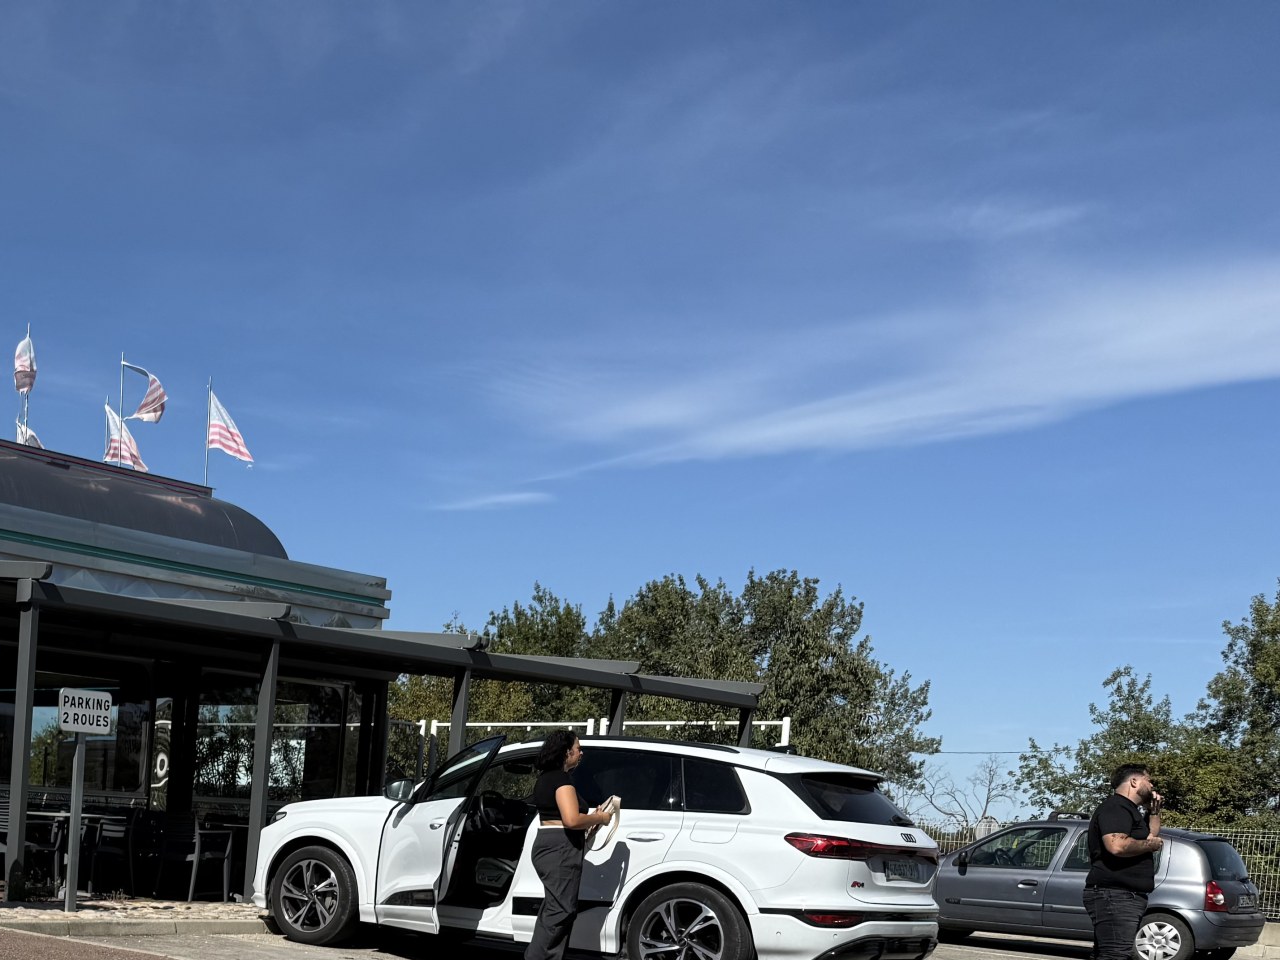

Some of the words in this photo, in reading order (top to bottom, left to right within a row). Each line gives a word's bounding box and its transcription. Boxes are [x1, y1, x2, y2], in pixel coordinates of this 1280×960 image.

[63, 695, 111, 712] PARKING
[62, 711, 69, 724] 2
[72, 713, 109, 727] ROUES
